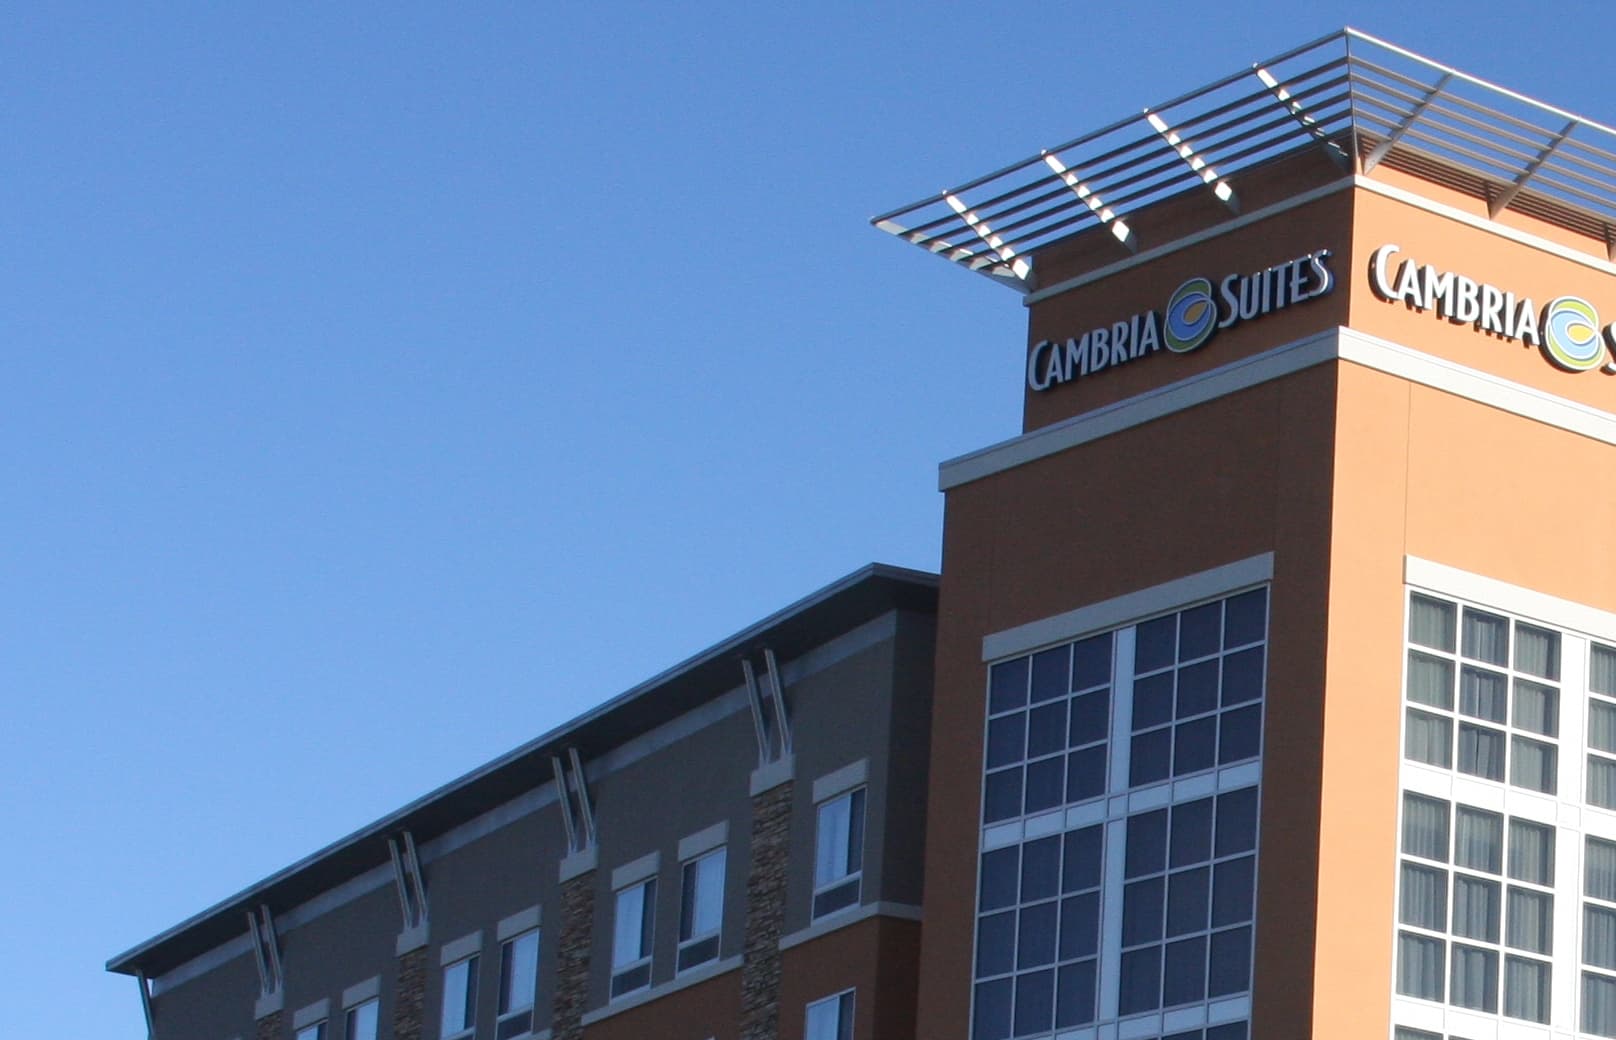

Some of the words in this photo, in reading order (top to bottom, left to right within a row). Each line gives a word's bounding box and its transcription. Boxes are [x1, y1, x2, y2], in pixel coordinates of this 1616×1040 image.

[1028, 309, 1160, 391] CAMBRIA
[1218, 248, 1335, 329] SUITES
[1371, 243, 1541, 346] CAMBRIA
